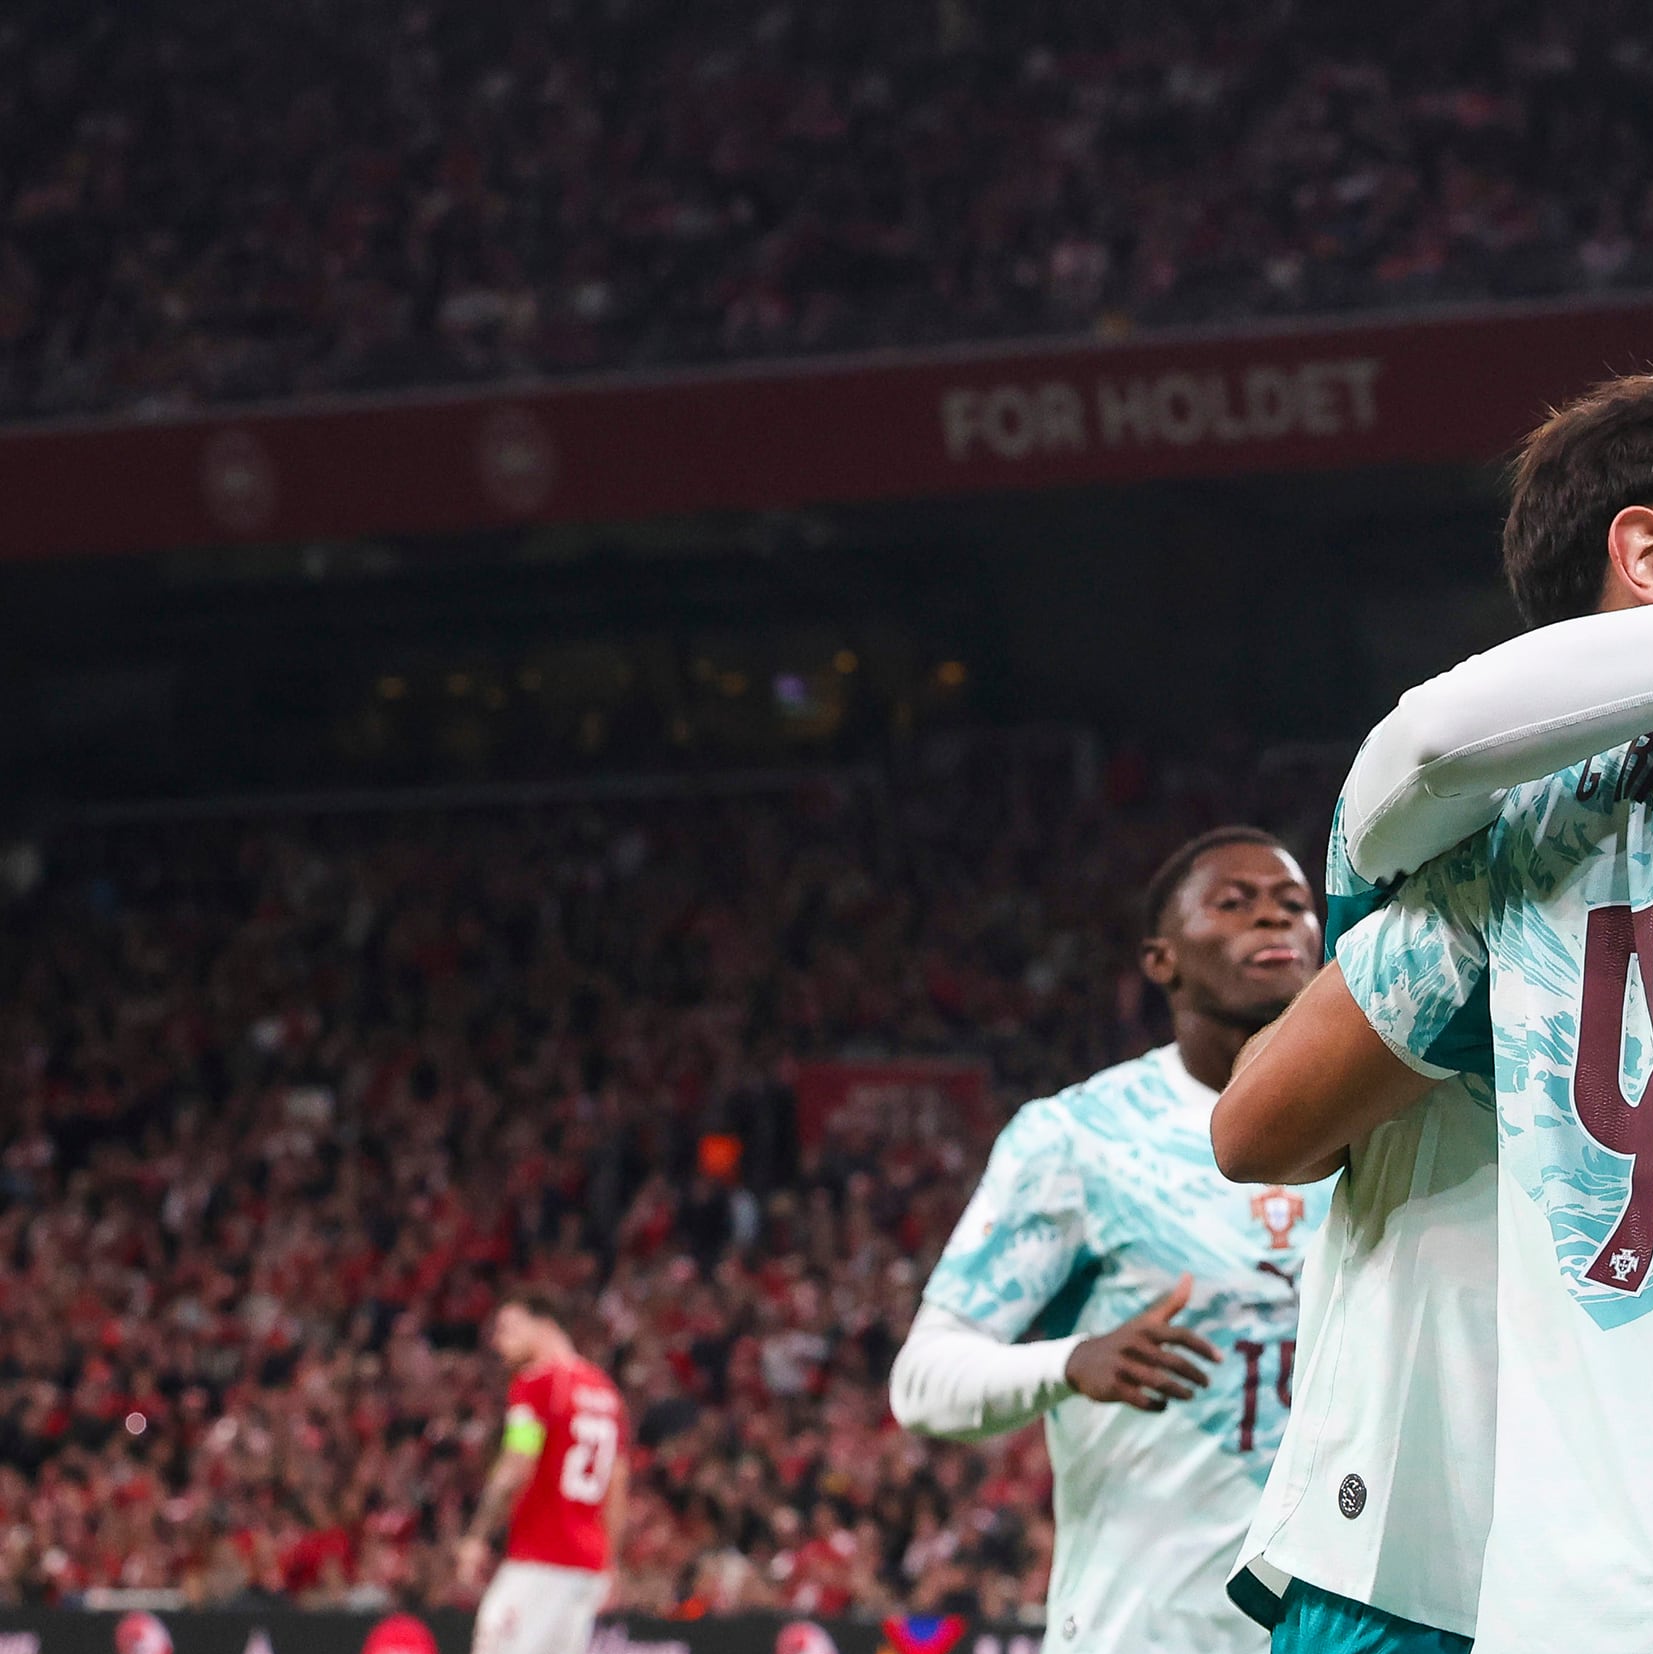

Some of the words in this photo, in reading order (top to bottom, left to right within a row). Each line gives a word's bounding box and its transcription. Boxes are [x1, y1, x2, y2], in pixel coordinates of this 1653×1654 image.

[942, 384, 1086, 461] FOR
[1097, 357, 1383, 446] HOLDET
[1234, 1340, 1295, 1452] 1
